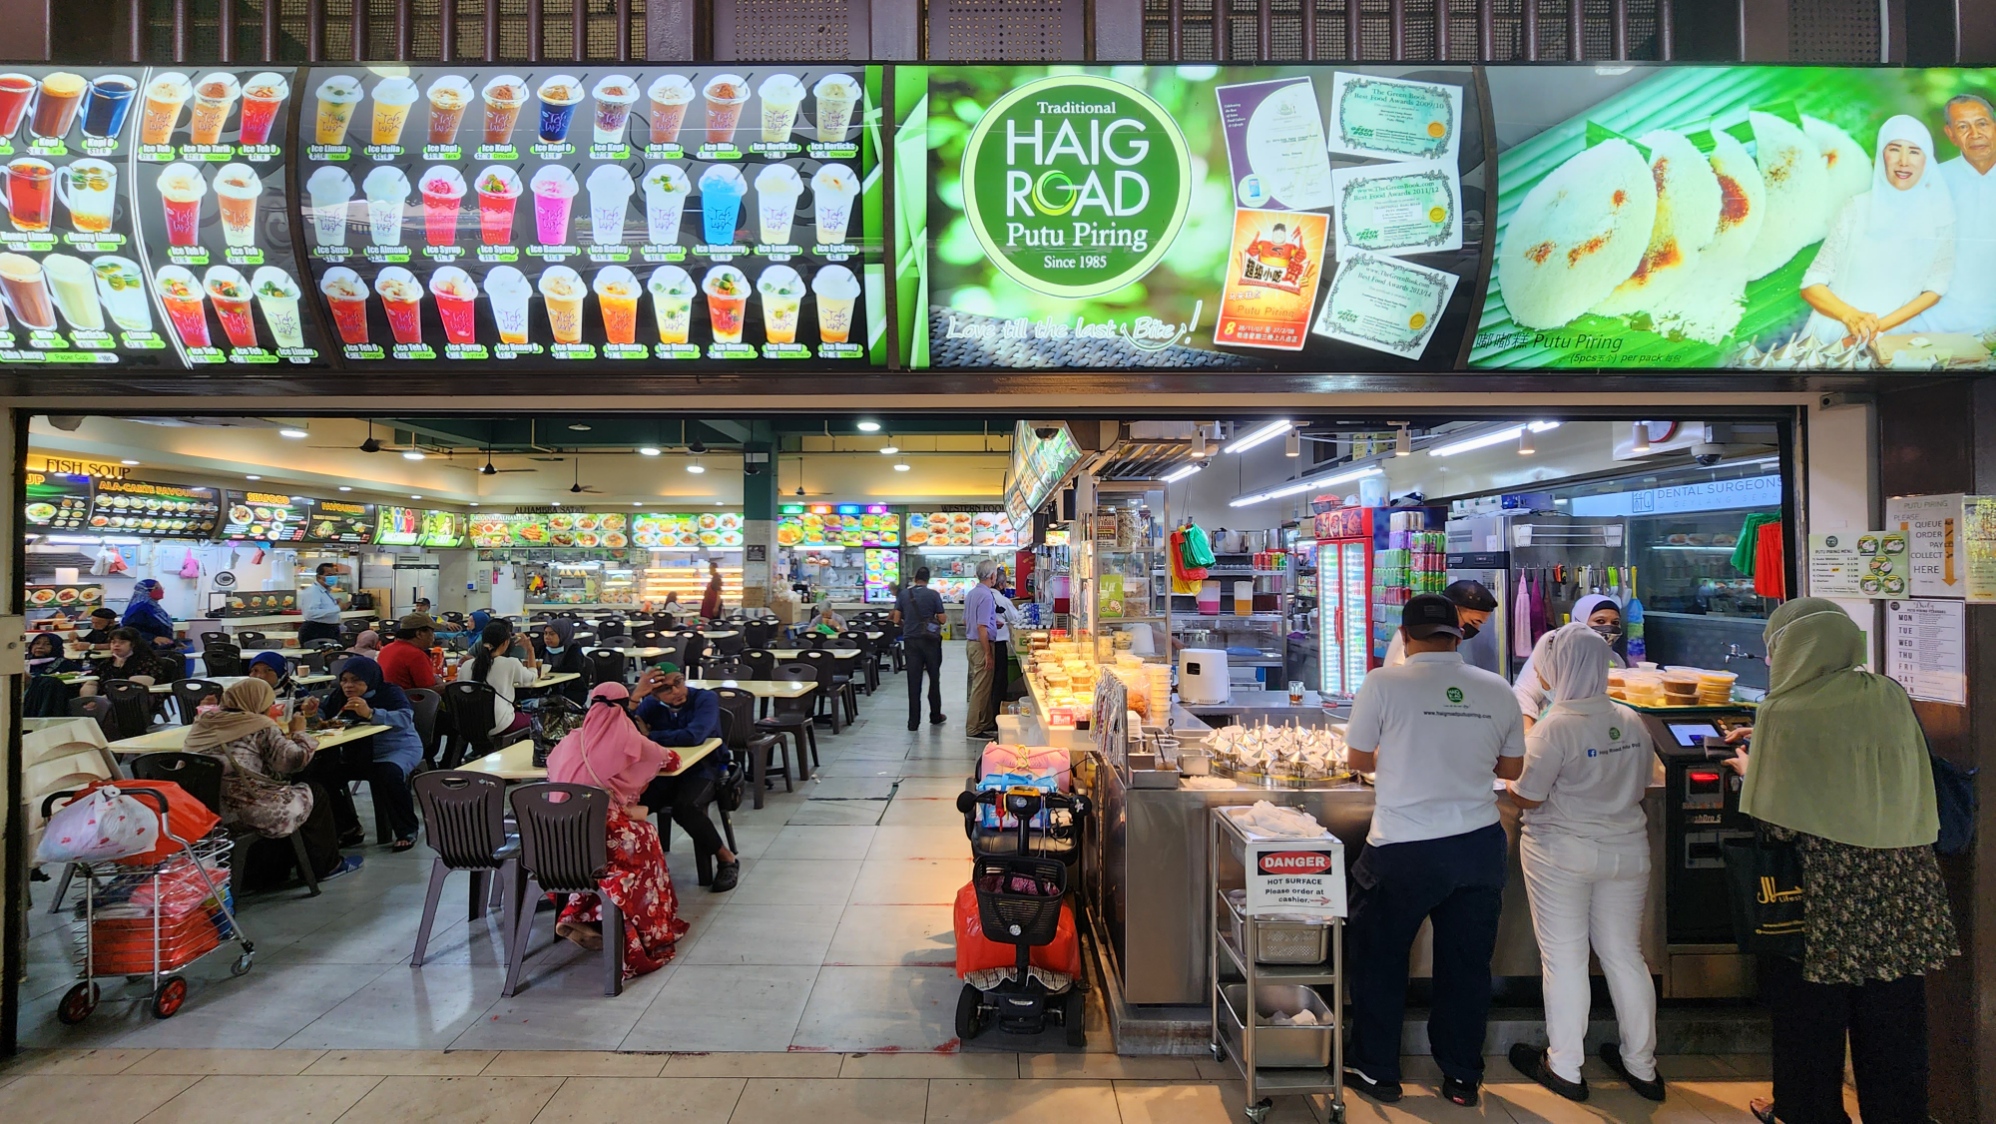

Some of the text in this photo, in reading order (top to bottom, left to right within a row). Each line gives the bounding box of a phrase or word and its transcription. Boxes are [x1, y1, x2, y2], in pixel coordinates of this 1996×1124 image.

[1372, 88, 1427, 101] The Green Book
[1036, 101, 1116, 114] Traditional
[1369, 95, 1387, 103] Food
[1388, 98, 1415, 106] Awards
[1415, 100, 1445, 110] 2009/10
[1006, 118, 1150, 166] HAIG
[311, 145, 324, 153] Ice
[367, 145, 380, 153] Ice
[427, 144, 457, 153] Ice Kopi
[481, 144, 512, 153] Ice Kopi
[534, 144, 547, 153] Ice
[547, 144, 565, 153] Kopi
[1006, 169, 1150, 216] ROAD
[1357, 182, 1435, 194] www.TheGreenBook.com
[1387, 190, 1411, 199] Awards
[1412, 187, 1439, 196] 2011/12
[1006, 221, 1148, 252] Putu Piring
[1043, 255, 1107, 269] Since 1985
[1357, 272, 1432, 299] Best Food Awards 2013/14
[1237, 305, 1295, 318] Putu Piring
[946, 315, 995, 340] Love
[1002, 316, 1027, 339] till
[1034, 315, 1068, 340] the
[1075, 316, 1117, 340] last
[1224, 321, 1236, 335] 8
[1532, 333, 1571, 349] Putu
[1574, 333, 1624, 352] Piring
[1620, 354, 1638, 364] per
[1638, 354, 1663, 363] pack
[46, 458, 131, 480] FISH SOUP
[99, 480, 156, 495] ALA-CARTE
[1657, 477, 1782, 500] DENTAL SURGEONS
[247, 491, 291, 505] SEAFOOD
[514, 506, 558, 514] ALHAMBRA
[1903, 500, 1948, 510] PUTU PIRING
[1914, 520, 1943, 529] QUEUE
[1915, 531, 1943, 539] ORDER
[1910, 552, 1943, 560] COLLECT
[1913, 566, 1940, 574] HERE
[1898, 614, 1913, 622] MON
[1898, 651, 1913, 659] THU
[1898, 663, 1913, 671] FRI
[1898, 675, 1914, 684] SAT
[1265, 856, 1326, 868] DANGER
[1267, 878, 1323, 886] HOT SURFACE
[1292, 888, 1314, 896] order
[1316, 888, 1325, 896] at
[1278, 896, 1310, 904] cashier.
